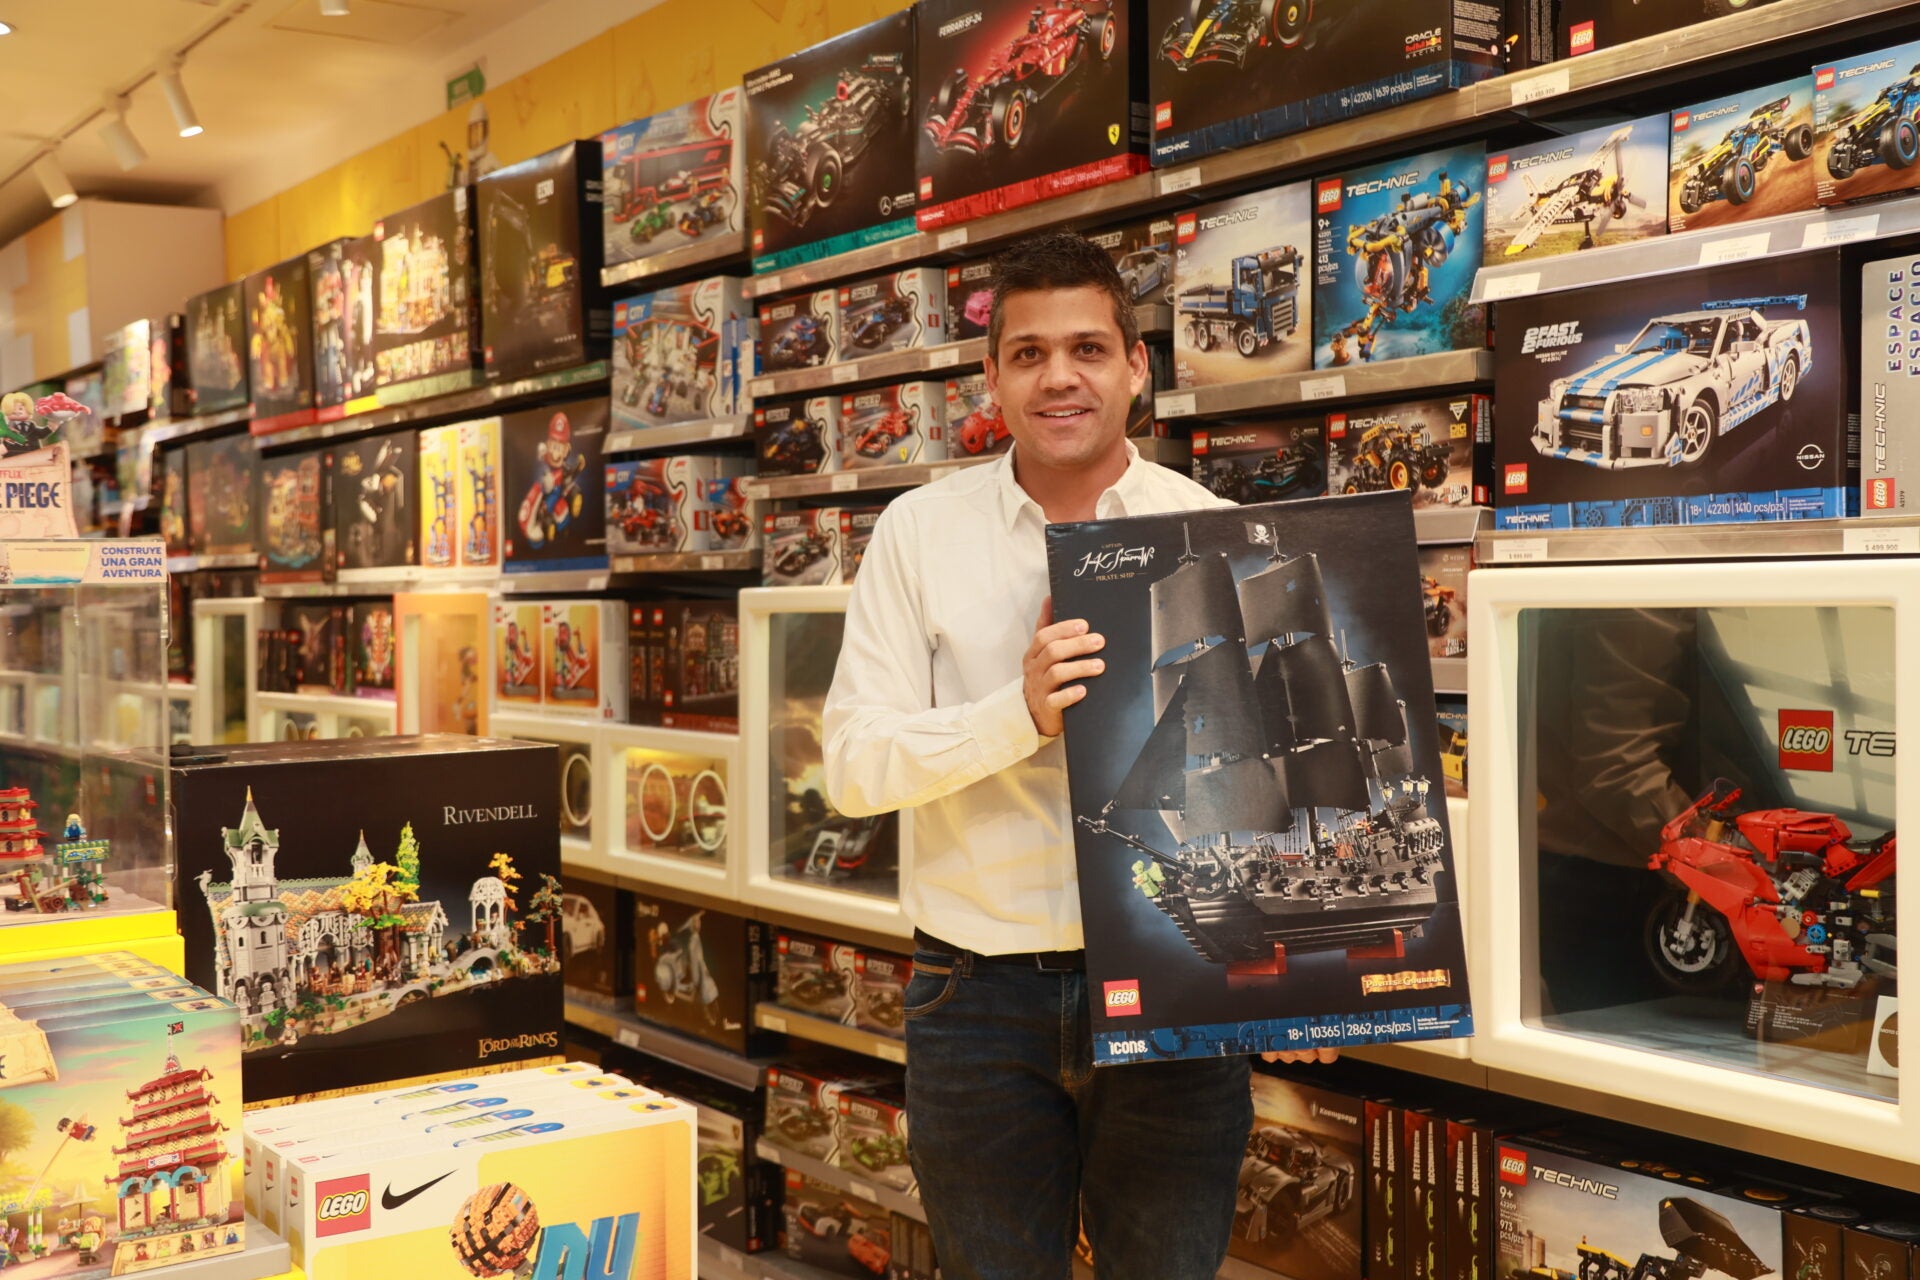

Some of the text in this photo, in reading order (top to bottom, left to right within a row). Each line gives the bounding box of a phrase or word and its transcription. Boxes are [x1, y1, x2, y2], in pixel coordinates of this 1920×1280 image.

[1405, 27, 1442, 45] ORACLE
[1571, 28, 1594, 48] LEGO
[1405, 45, 1442, 60] RACING
[1838, 59, 1897, 80] TECHNIC
[1353, 92, 1373, 105] 42206
[1375, 86, 1390, 98] 1639
[1692, 103, 1741, 123] TECHNIC
[1156, 140, 1190, 156] TECHNIC
[1488, 147, 1574, 178] LEGO TECHNIC
[1319, 171, 1419, 206] LEGO TECHNIC
[1178, 220, 1195, 237] LEGO
[1199, 206, 1259, 231] TECHNIC
[1318, 219, 1330, 230] 9+
[1538, 320, 1580, 340] FAST
[1889, 270, 1904, 372] ESPACE
[1535, 332, 1583, 350] FURIOUS
[1349, 415, 1398, 429] TECHNIC
[1874, 382, 1887, 473] TECHNIC
[1211, 434, 1257, 448] TECHNIC
[1796, 453, 1826, 461] NISSAN
[1505, 471, 1527, 487] LEGO
[6, 482, 62, 508] PIECE
[1873, 479, 1888, 507] LEGO
[1690, 504, 1703, 516] 18+
[1707, 502, 1731, 515] 42210
[1735, 501, 1752, 513] 1410
[1753, 500, 1785, 514] pcs/pzs
[1504, 513, 1550, 525] TECHNIC
[101, 546, 162, 555] CONSTRUYE
[101, 557, 162, 567] UNA GRAN
[102, 569, 162, 578] AVENTURA
[1096, 571, 1135, 583] PIRATE SHIP
[1782, 727, 1831, 753] LEGO
[1107, 989, 1139, 1007] LEGO
[1287, 1028, 1304, 1041] 18+
[1310, 1024, 1341, 1039] 10365
[1347, 1022, 1372, 1037] 2862
[1374, 1020, 1412, 1037] pcs/pzs
[478, 1038, 511, 1059] LORD
[519, 1031, 559, 1049] RINGS
[1318, 1106, 1359, 1126] Koenigsegg
[1501, 1156, 1620, 1200] LEGO TECHNIC
[1500, 1186, 1514, 1199] 9+
[318, 1189, 369, 1220] LEGO
[1500, 1219, 1513, 1232] 973
